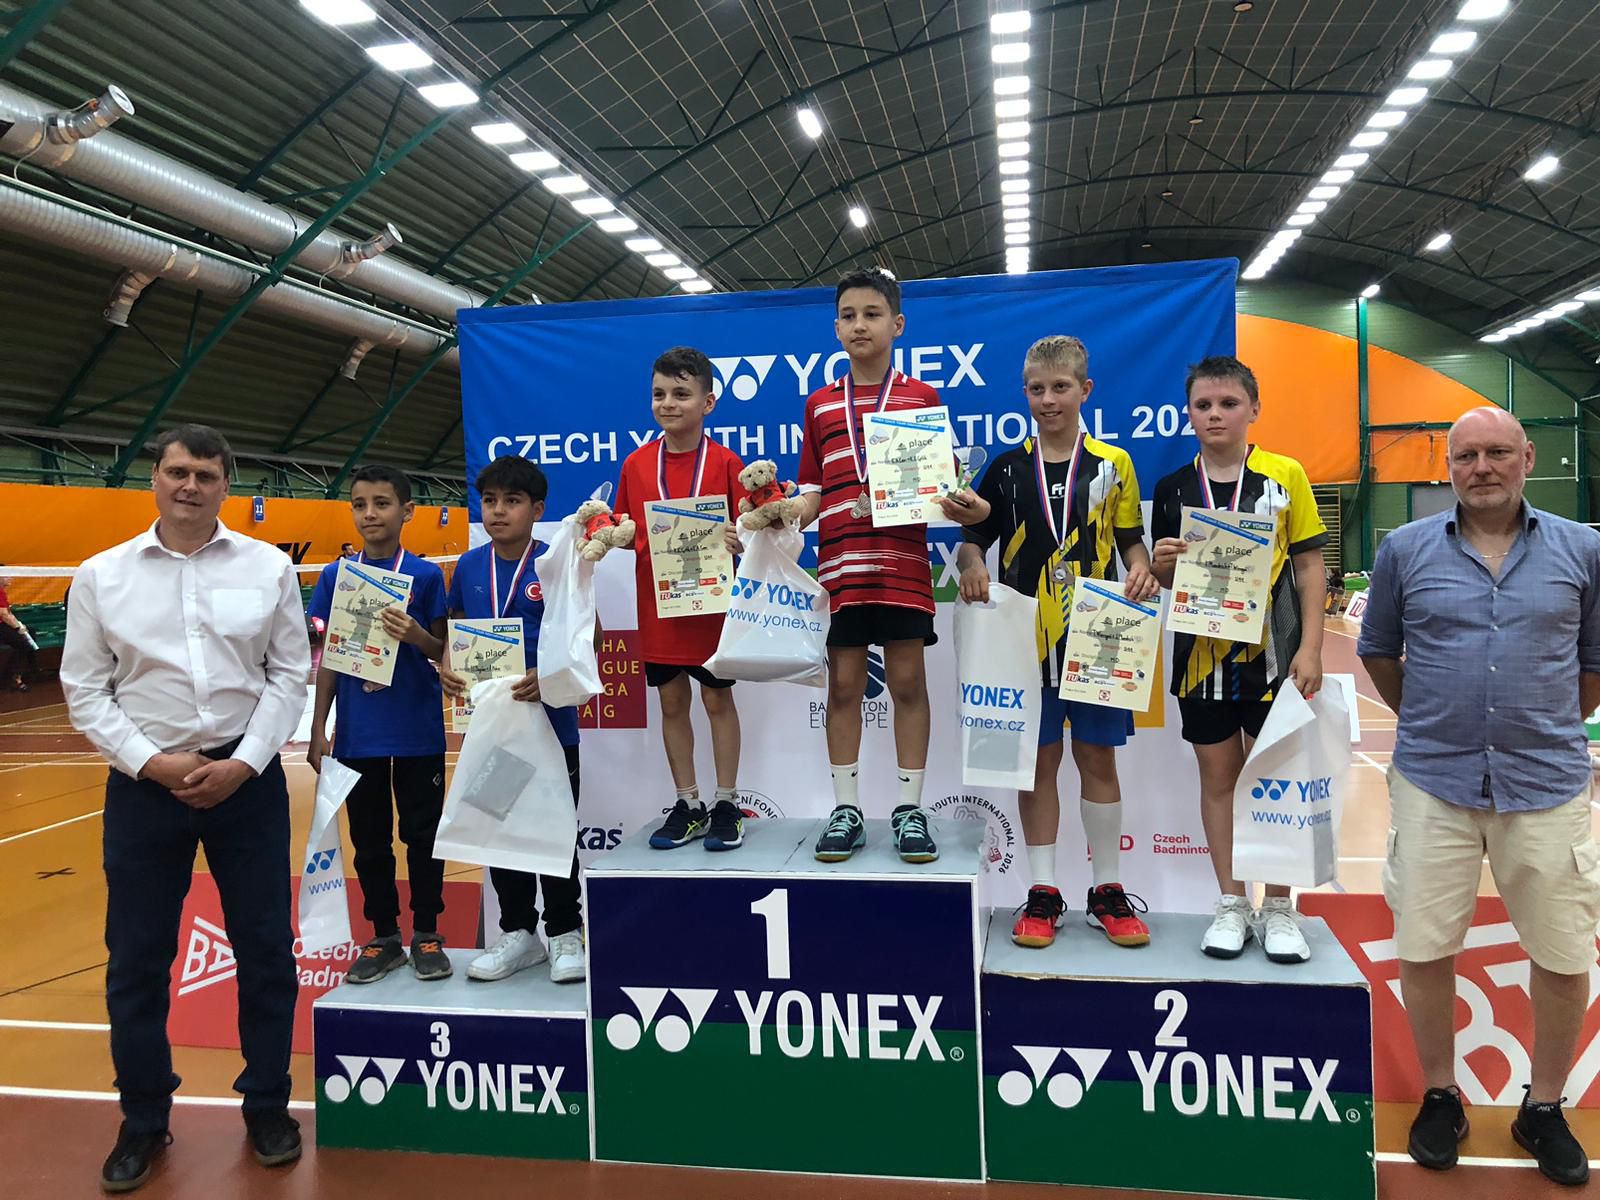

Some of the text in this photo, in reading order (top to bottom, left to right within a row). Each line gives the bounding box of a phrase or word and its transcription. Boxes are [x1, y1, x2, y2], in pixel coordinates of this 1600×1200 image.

[784, 343, 986, 396] YOEX
[488, 431, 618, 465] CZECH
[628, 425, 764, 457] YTH
[1132, 404, 1197, 439] 202
[908, 438, 933, 449] place
[690, 527, 713, 537] place
[1225, 545, 1252, 556] place
[1115, 616, 1141, 627] place
[1174, 604, 1199, 615] TUkas
[485, 649, 507, 659] place
[810, 701, 888, 712] BATON
[961, 683, 1025, 709] YONEX
[1296, 777, 1331, 802] YONEX
[929, 795, 959, 813] YOUTH
[961, 795, 1015, 847] INTERNATIONAL
[998, 852, 1015, 874] 2026
[1153, 833, 1190, 844] Czech
[1153, 844, 1211, 854] Badminto
[750, 888, 791, 980] 1
[292, 938, 363, 961] Cech
[734, 989, 946, 1062] YONEX
[1153, 989, 1189, 1048] 2
[430, 1021, 451, 1058] 3
[416, 1060, 567, 1115] YONEX
[1128, 1050, 1342, 1123] YONEX
